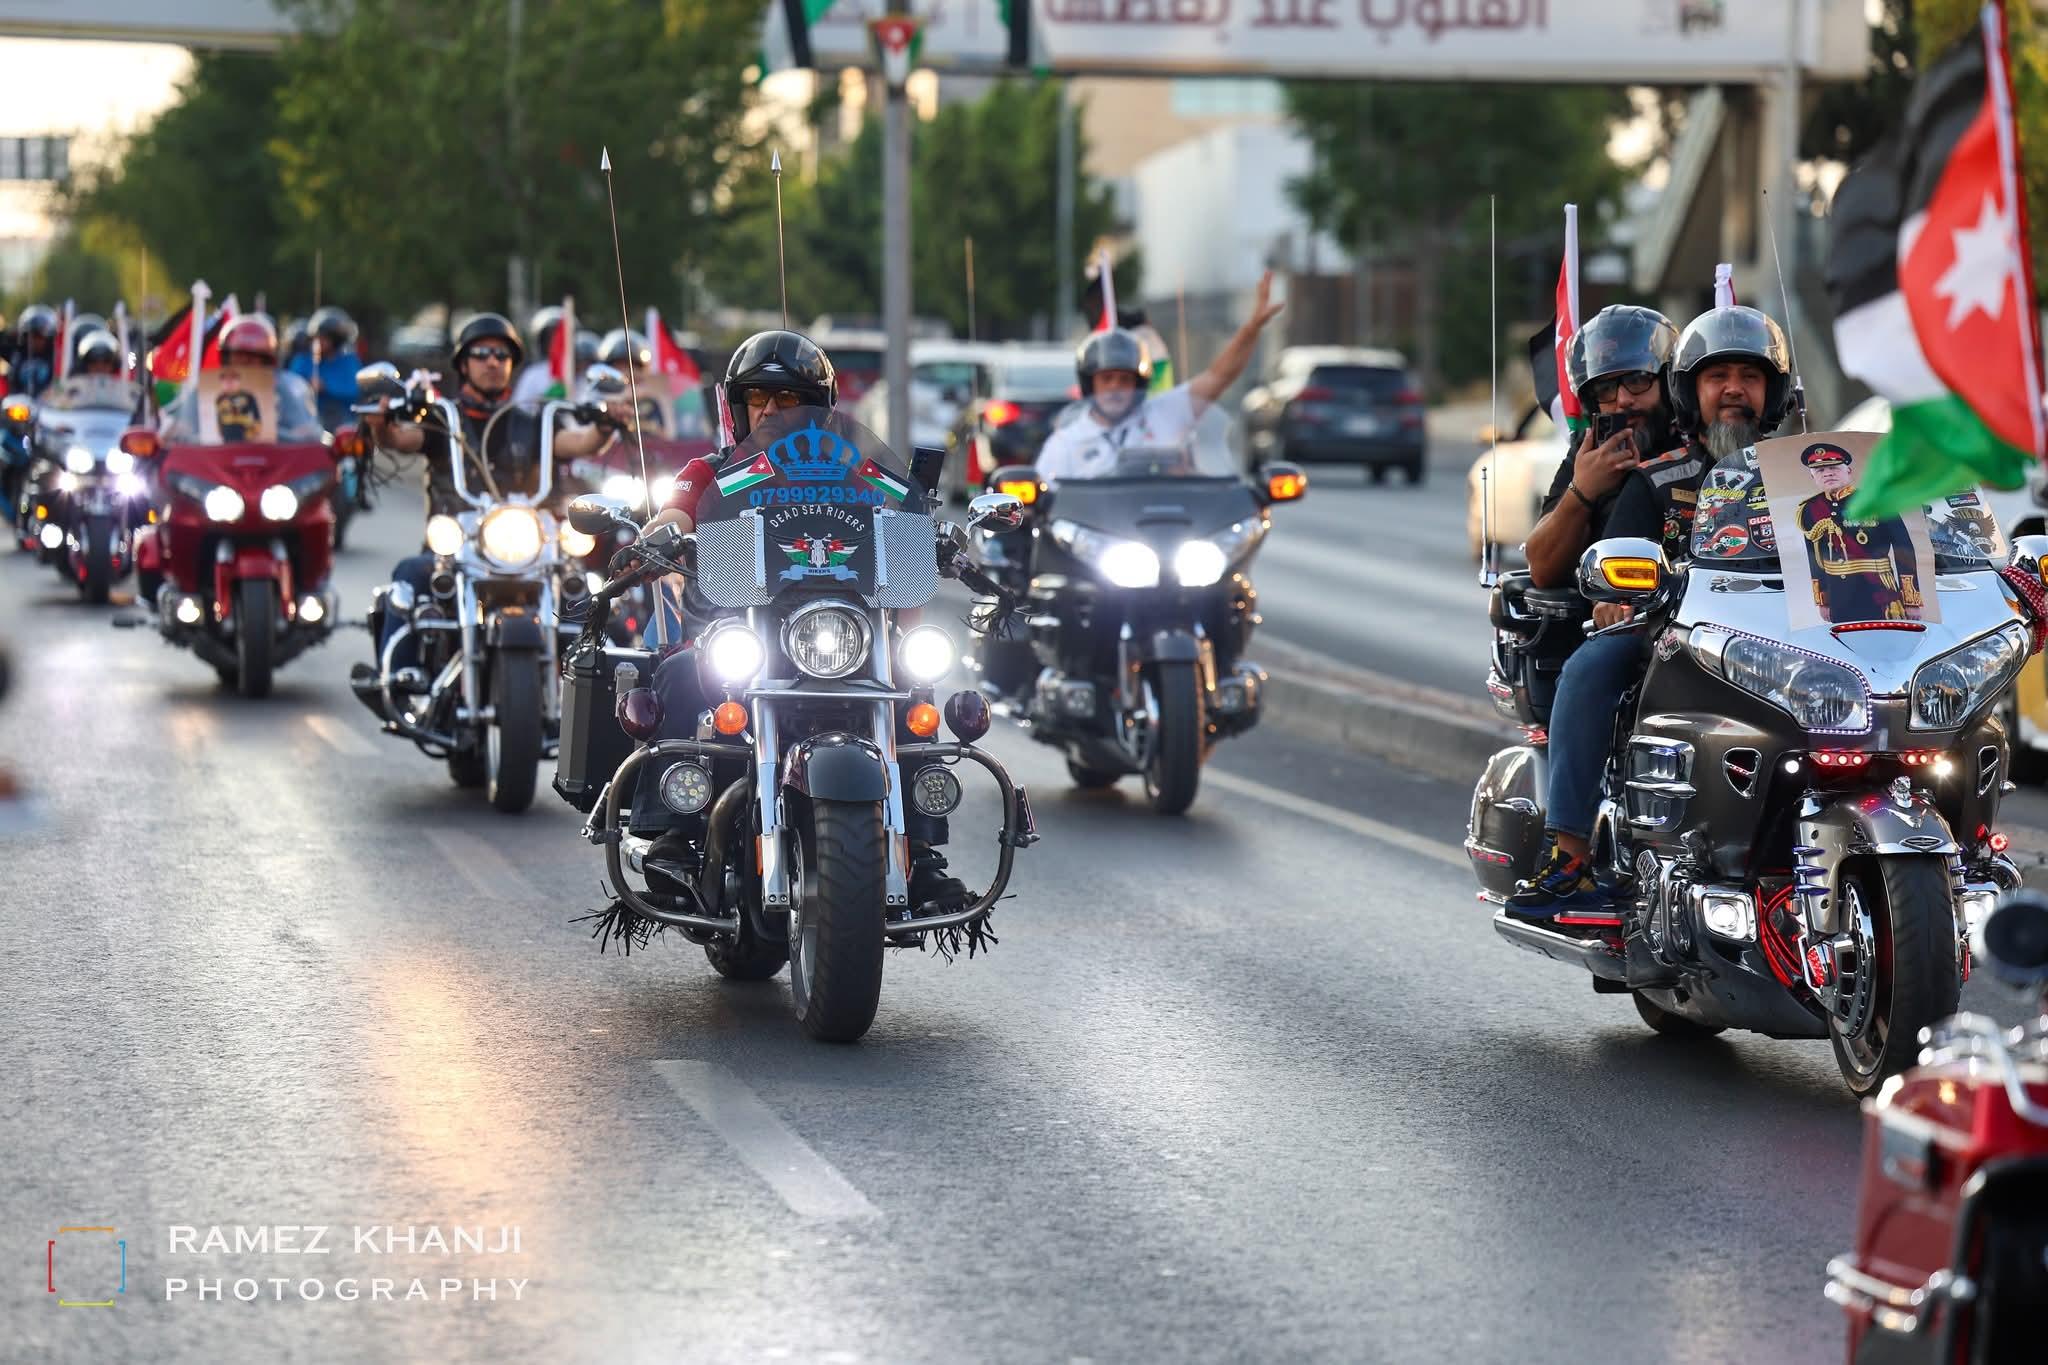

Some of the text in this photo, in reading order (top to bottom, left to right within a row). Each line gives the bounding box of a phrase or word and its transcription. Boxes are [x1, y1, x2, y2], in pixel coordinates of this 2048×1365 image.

[750, 486, 886, 506] 0799929340
[769, 504, 865, 532] DEAD SEA RIDERS
